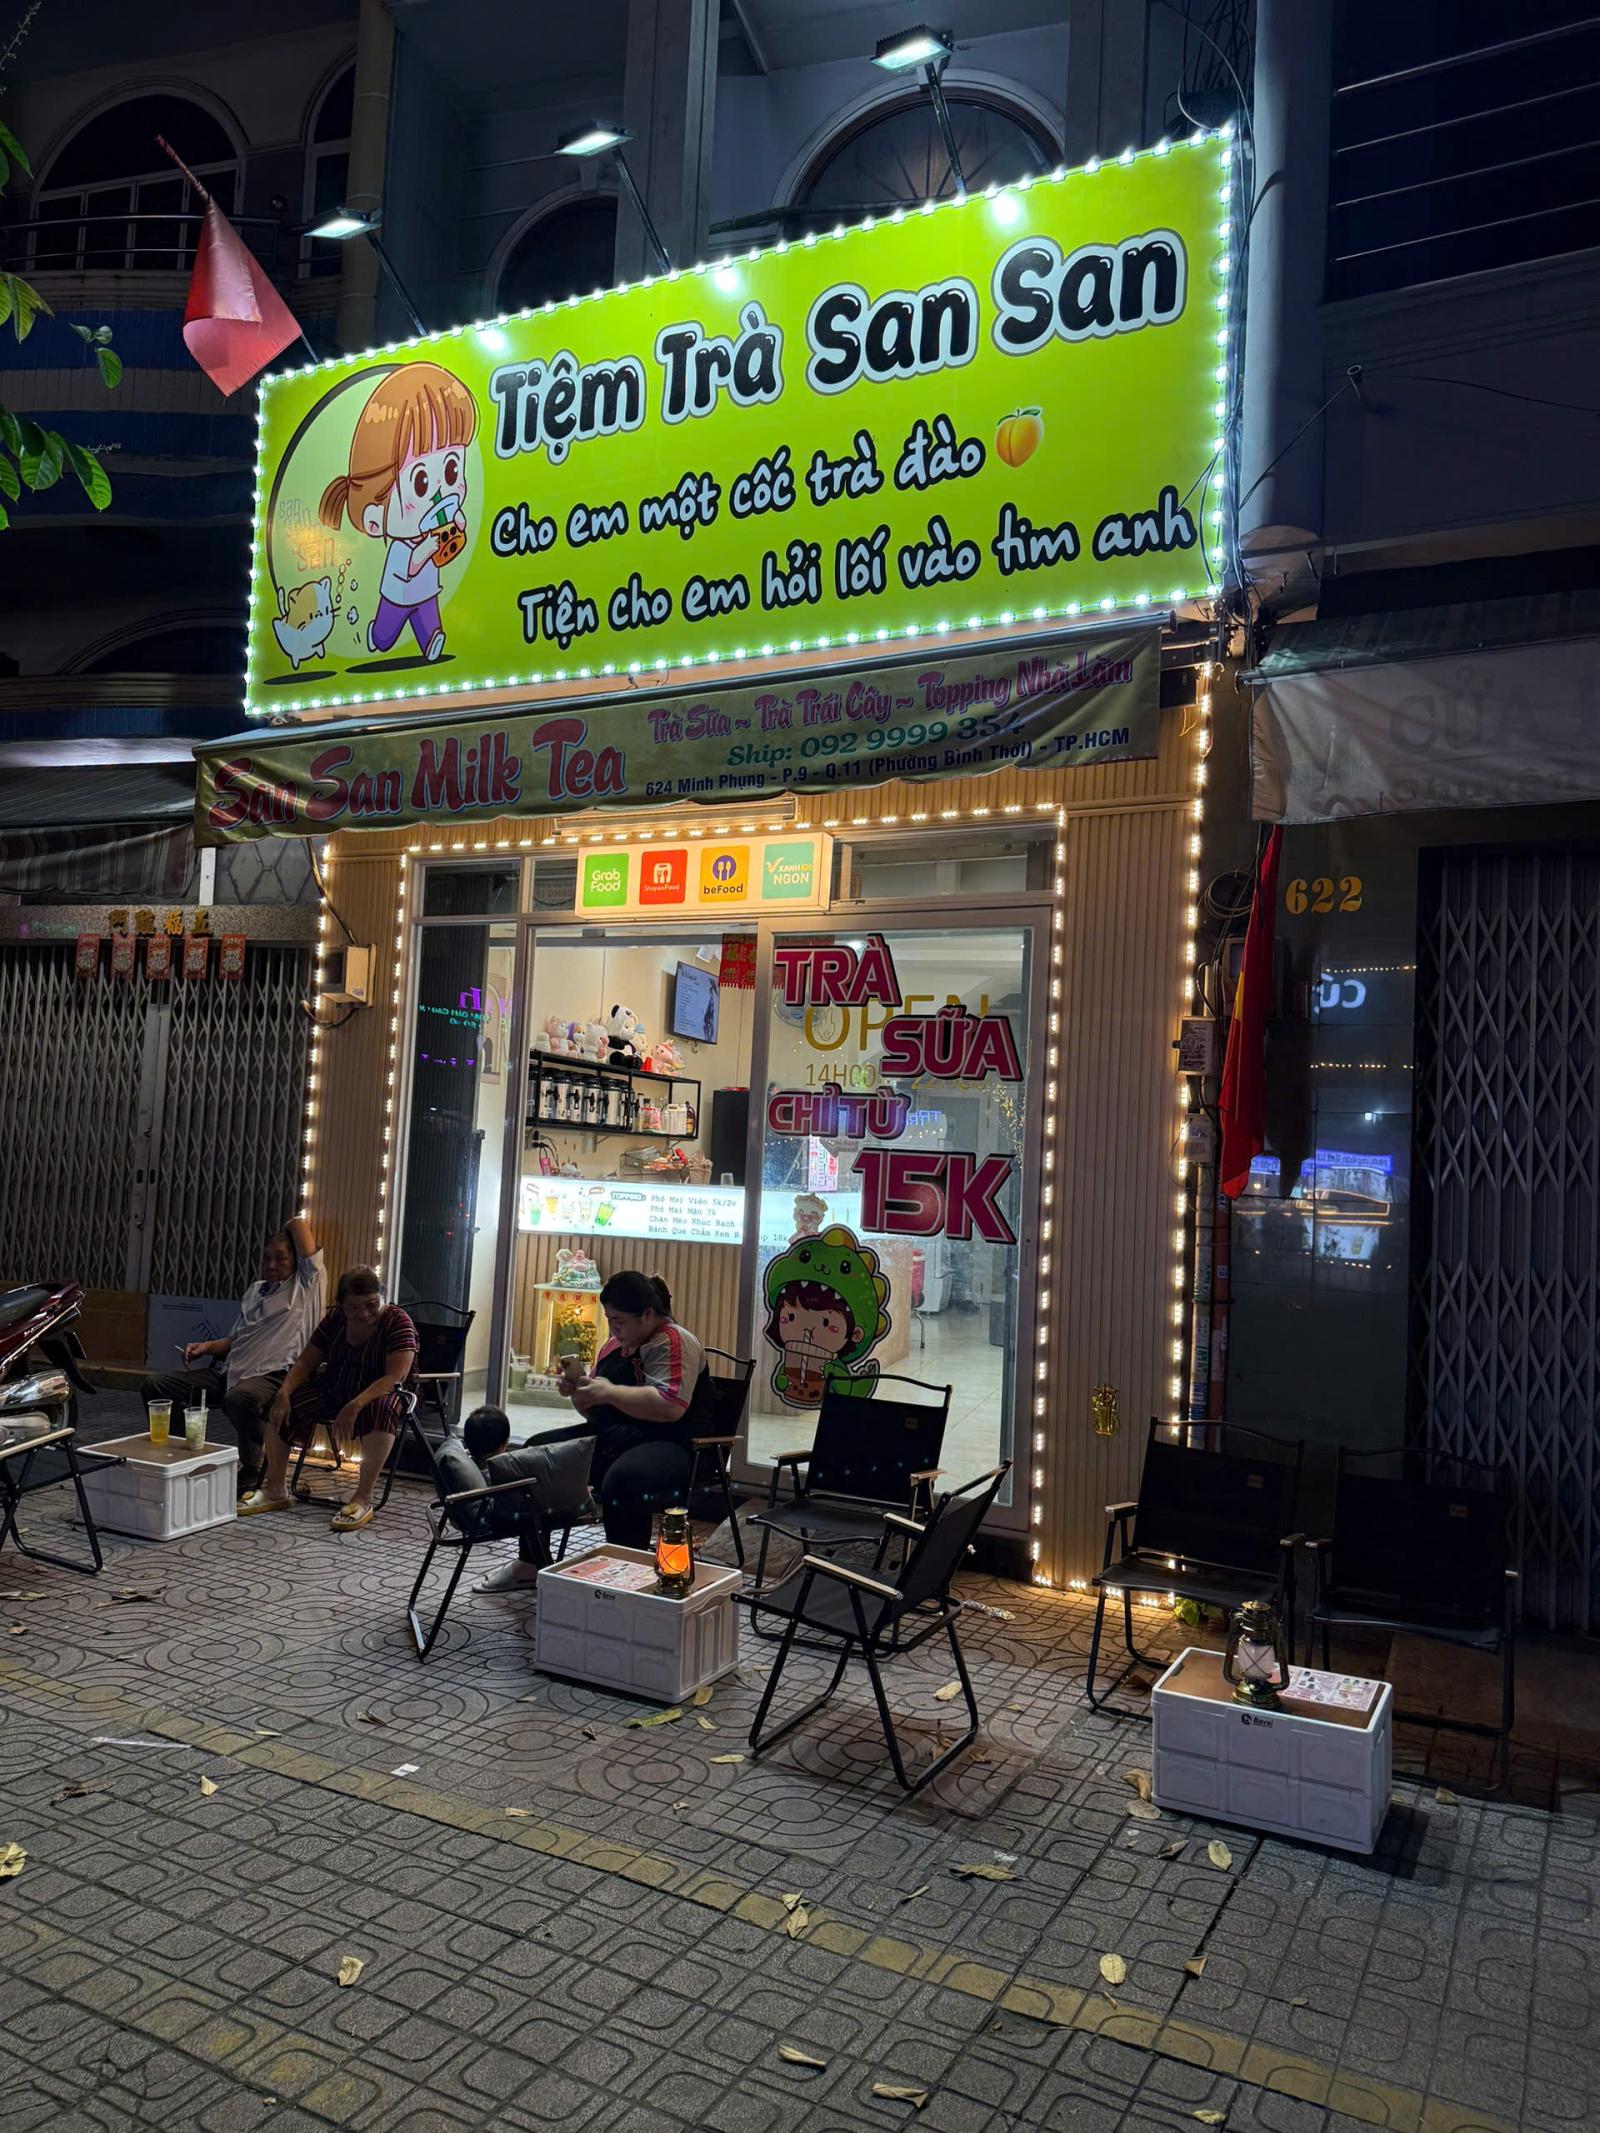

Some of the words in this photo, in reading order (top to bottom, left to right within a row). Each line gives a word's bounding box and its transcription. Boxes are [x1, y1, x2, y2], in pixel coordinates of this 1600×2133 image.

[491, 351, 644, 463] Tiệm
[655, 302, 783, 423] Trà
[806, 278, 979, 395] San
[992, 229, 1187, 354] San
[491, 502, 557, 556] Cho
[566, 501, 628, 547] em
[640, 472, 720, 539] một
[730, 446, 795, 518] cốc
[806, 430, 884, 505] trà
[894, 414, 985, 490] đào
[518, 580, 598, 649] Tiện
[608, 573, 672, 632] cho
[682, 574, 750, 621] em
[762, 540, 821, 609] hỏi
[835, 525, 890, 599] lối
[899, 515, 981, 589] vào
[993, 503, 1079, 575] tim
[1093, 486, 1196, 561] anh
[648, 709, 684, 744] Trà
[685, 704, 732, 740] Sữa
[755, 694, 793, 731] Trà
[796, 688, 842, 726] Trái
[845, 680, 892, 725] Cây
[917, 672, 1011, 715] Topping
[209, 758, 298, 830] San
[306, 746, 402, 822] San
[410, 732, 523, 813] Milk
[532, 718, 628, 800] Tea
[645, 781, 672, 797] 624
[678, 777, 714, 793] Minh
[718, 772, 765, 791] Phụng
[782, 766, 808, 784] P.9
[825, 760, 861, 780] Q.11
[868, 752, 938, 778] (Phường
[944, 746, 983, 767] Bình
[989, 741, 1032, 761] Thời)
[1054, 727, 1130, 753] TP.HCM
[726, 744, 793, 768] Ship:
[800, 732, 858, 758] 092
[866, 720, 949, 751] 9999
[590, 879, 621, 892] Food
[592, 869, 621, 881] Grab
[703, 884, 743, 894] beFood
[772, 872, 810, 885] NGON
[1285, 876, 1362, 915] 622
[774, 933, 902, 1007] TRÀ
[880, 1005, 1024, 1082] SỮA
[768, 1083, 840, 1137] CHỈ
[838, 1086, 911, 1140] TỪ
[850, 1147, 1018, 1245] 15K
